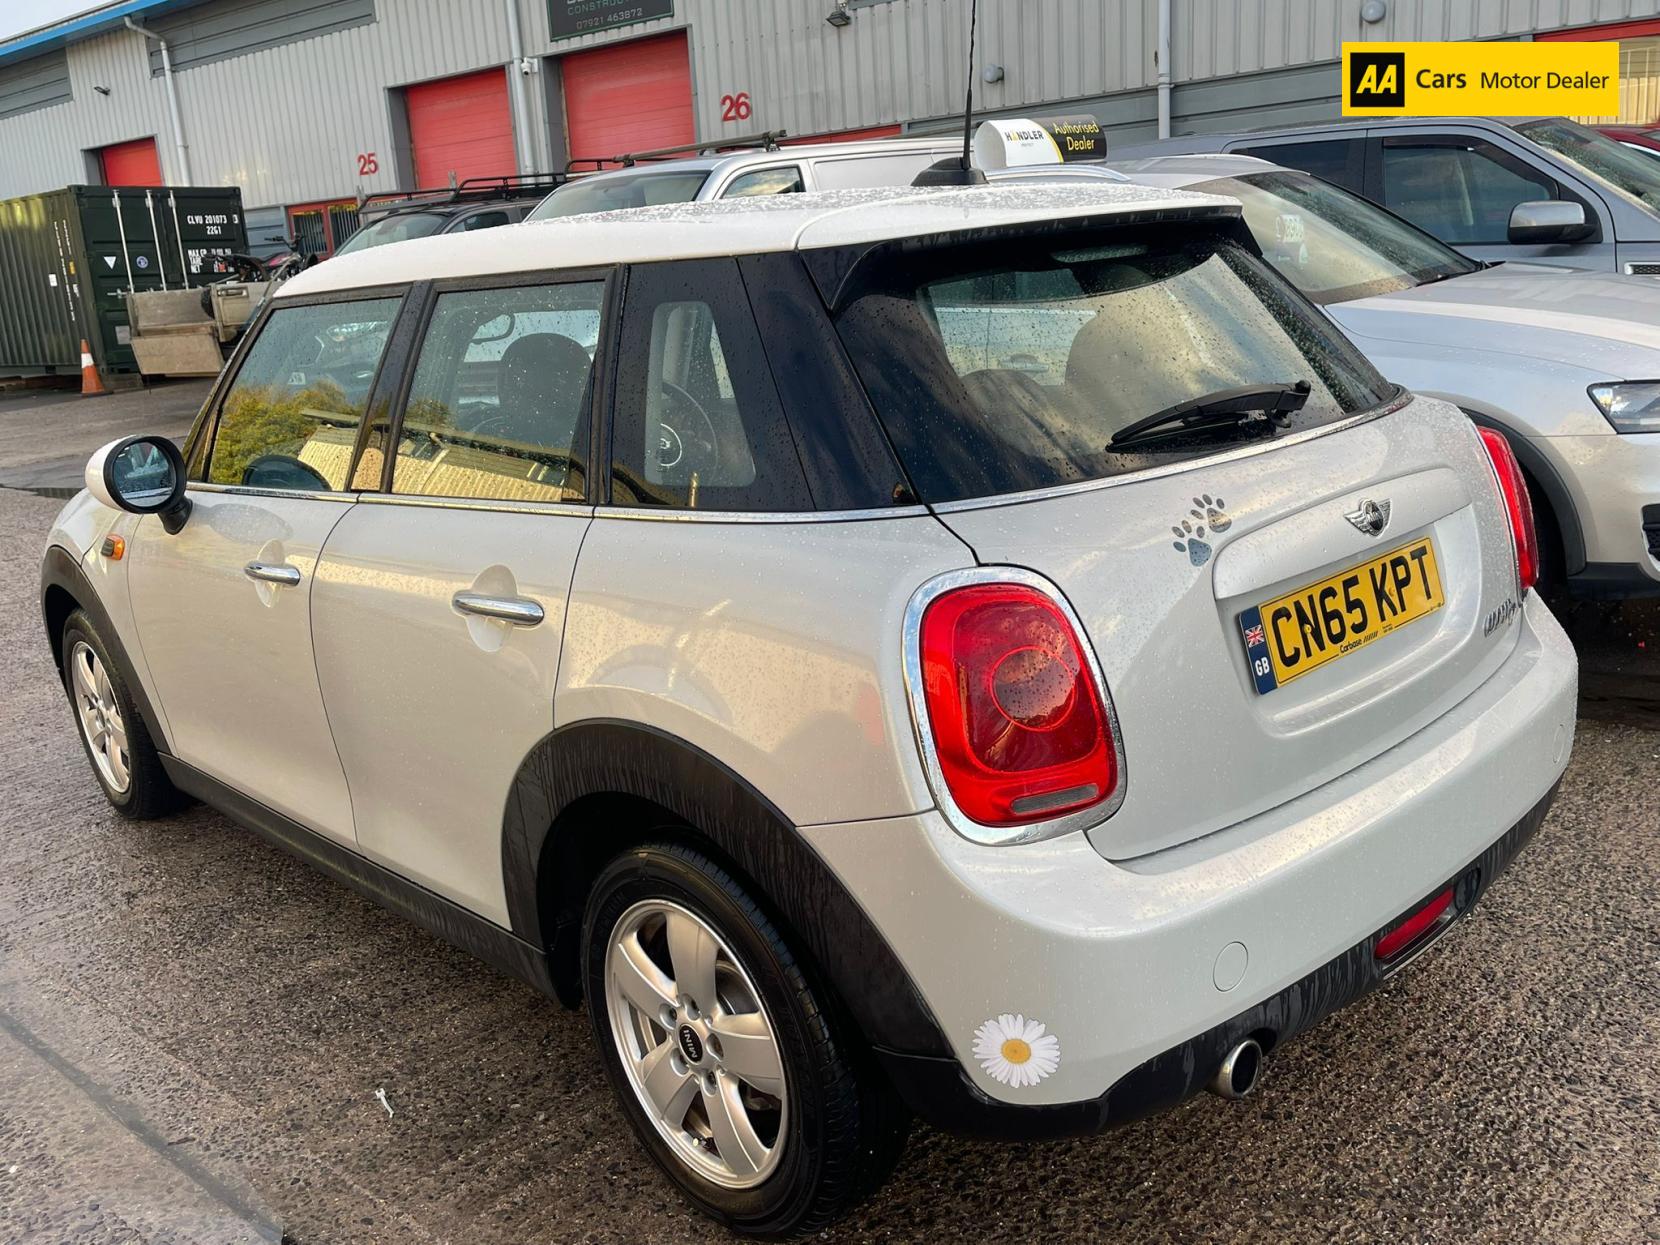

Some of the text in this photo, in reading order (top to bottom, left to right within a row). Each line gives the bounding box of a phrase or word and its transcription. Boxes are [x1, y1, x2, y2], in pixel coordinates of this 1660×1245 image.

[720, 92, 752, 121] 26
[1053, 121, 1100, 134] Authorised
[1067, 136, 1095, 151] Dealer
[357, 152, 379, 176] 25
[1271, 575, 1369, 668] CN65
[1369, 545, 1432, 622] KPT
[1255, 656, 1270, 677] GB
[683, 1029, 698, 1058] MINI
